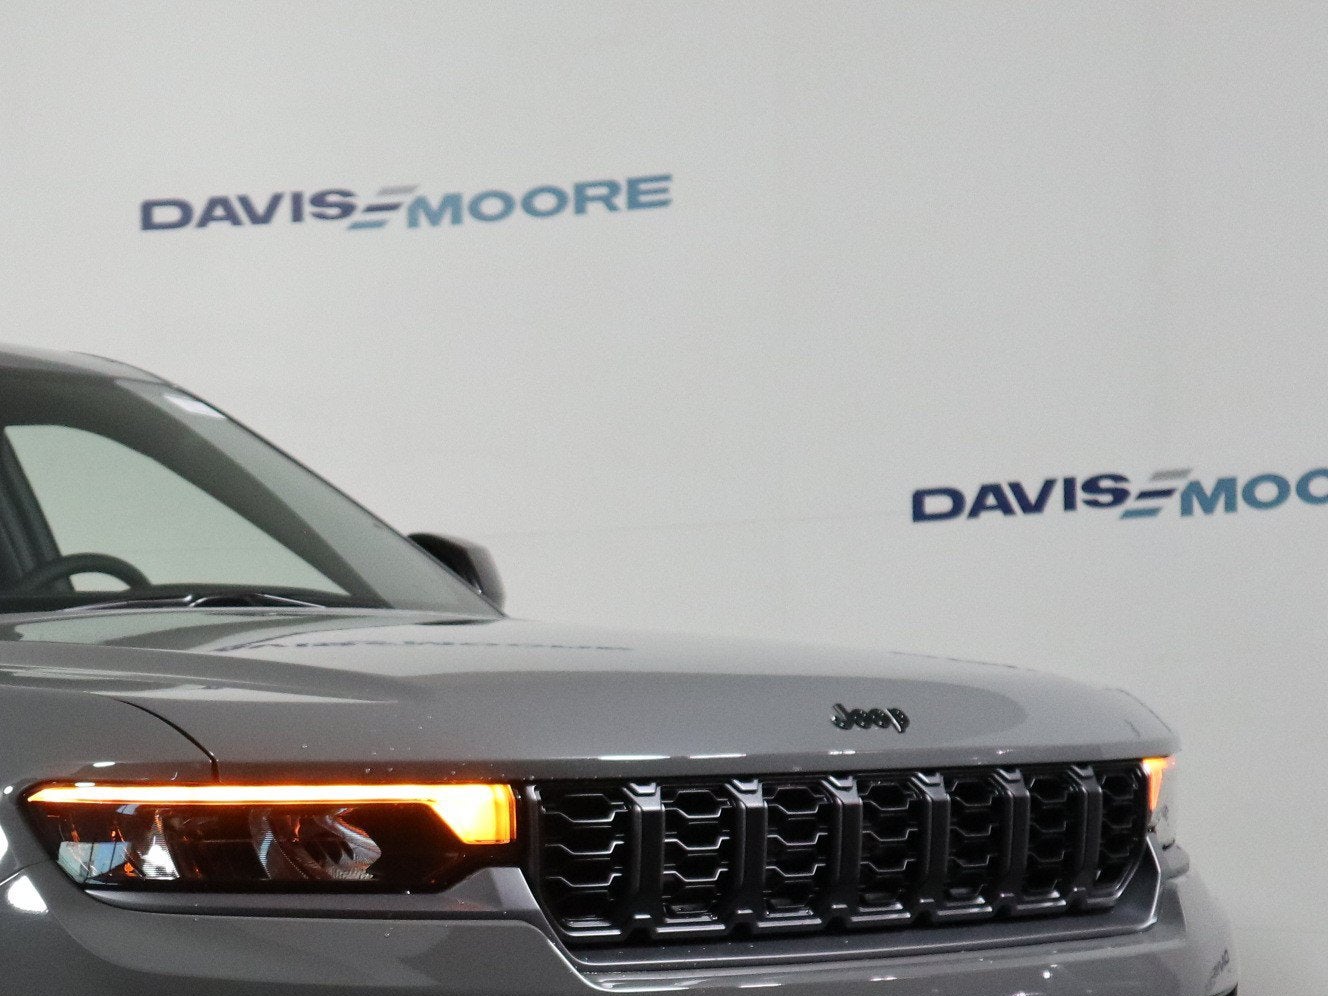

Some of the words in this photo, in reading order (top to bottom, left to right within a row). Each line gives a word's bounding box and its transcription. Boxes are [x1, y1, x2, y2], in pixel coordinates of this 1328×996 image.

[139, 187, 362, 231] DAVIS
[405, 173, 673, 229] MOORE
[911, 472, 1132, 523] DAVIS
[831, 703, 910, 733] Jeep
